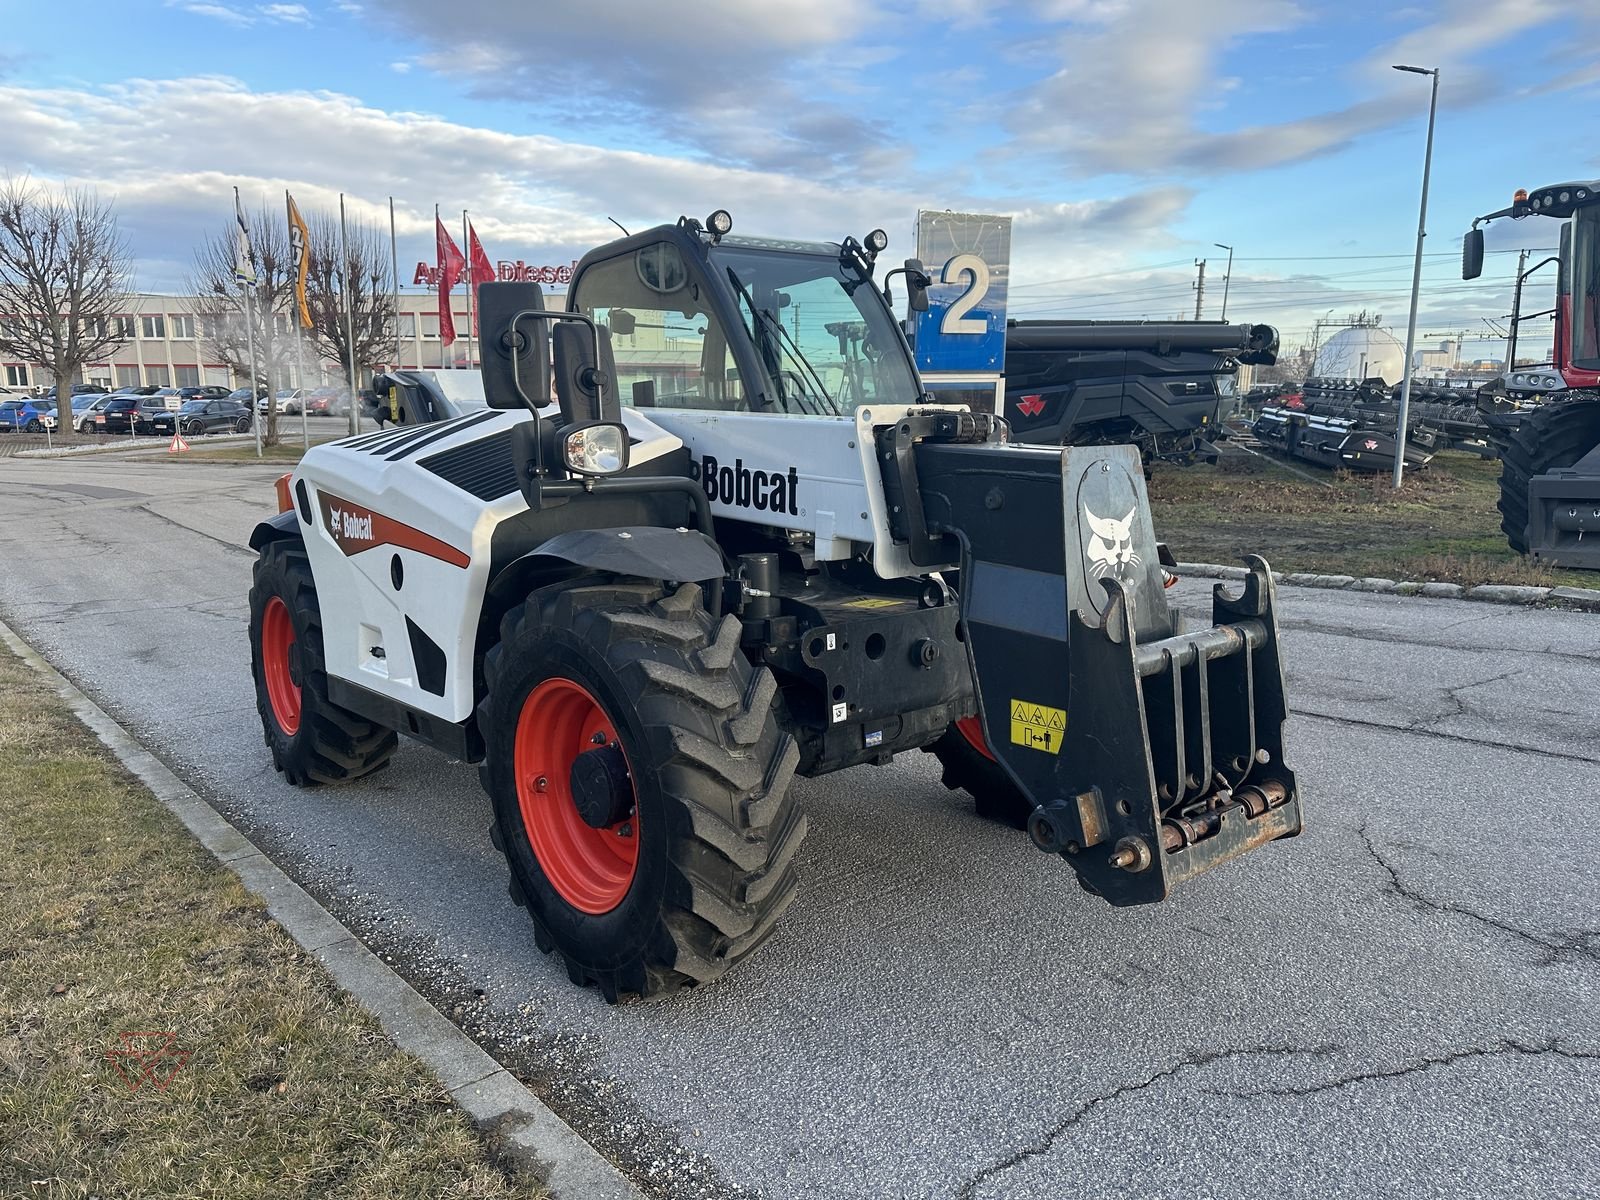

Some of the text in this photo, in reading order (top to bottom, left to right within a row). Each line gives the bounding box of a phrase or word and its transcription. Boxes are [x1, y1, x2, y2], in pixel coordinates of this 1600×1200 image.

[940, 254, 990, 334] 2
[702, 454, 799, 516] Bobcat
[343, 511, 373, 540] Bobcat
